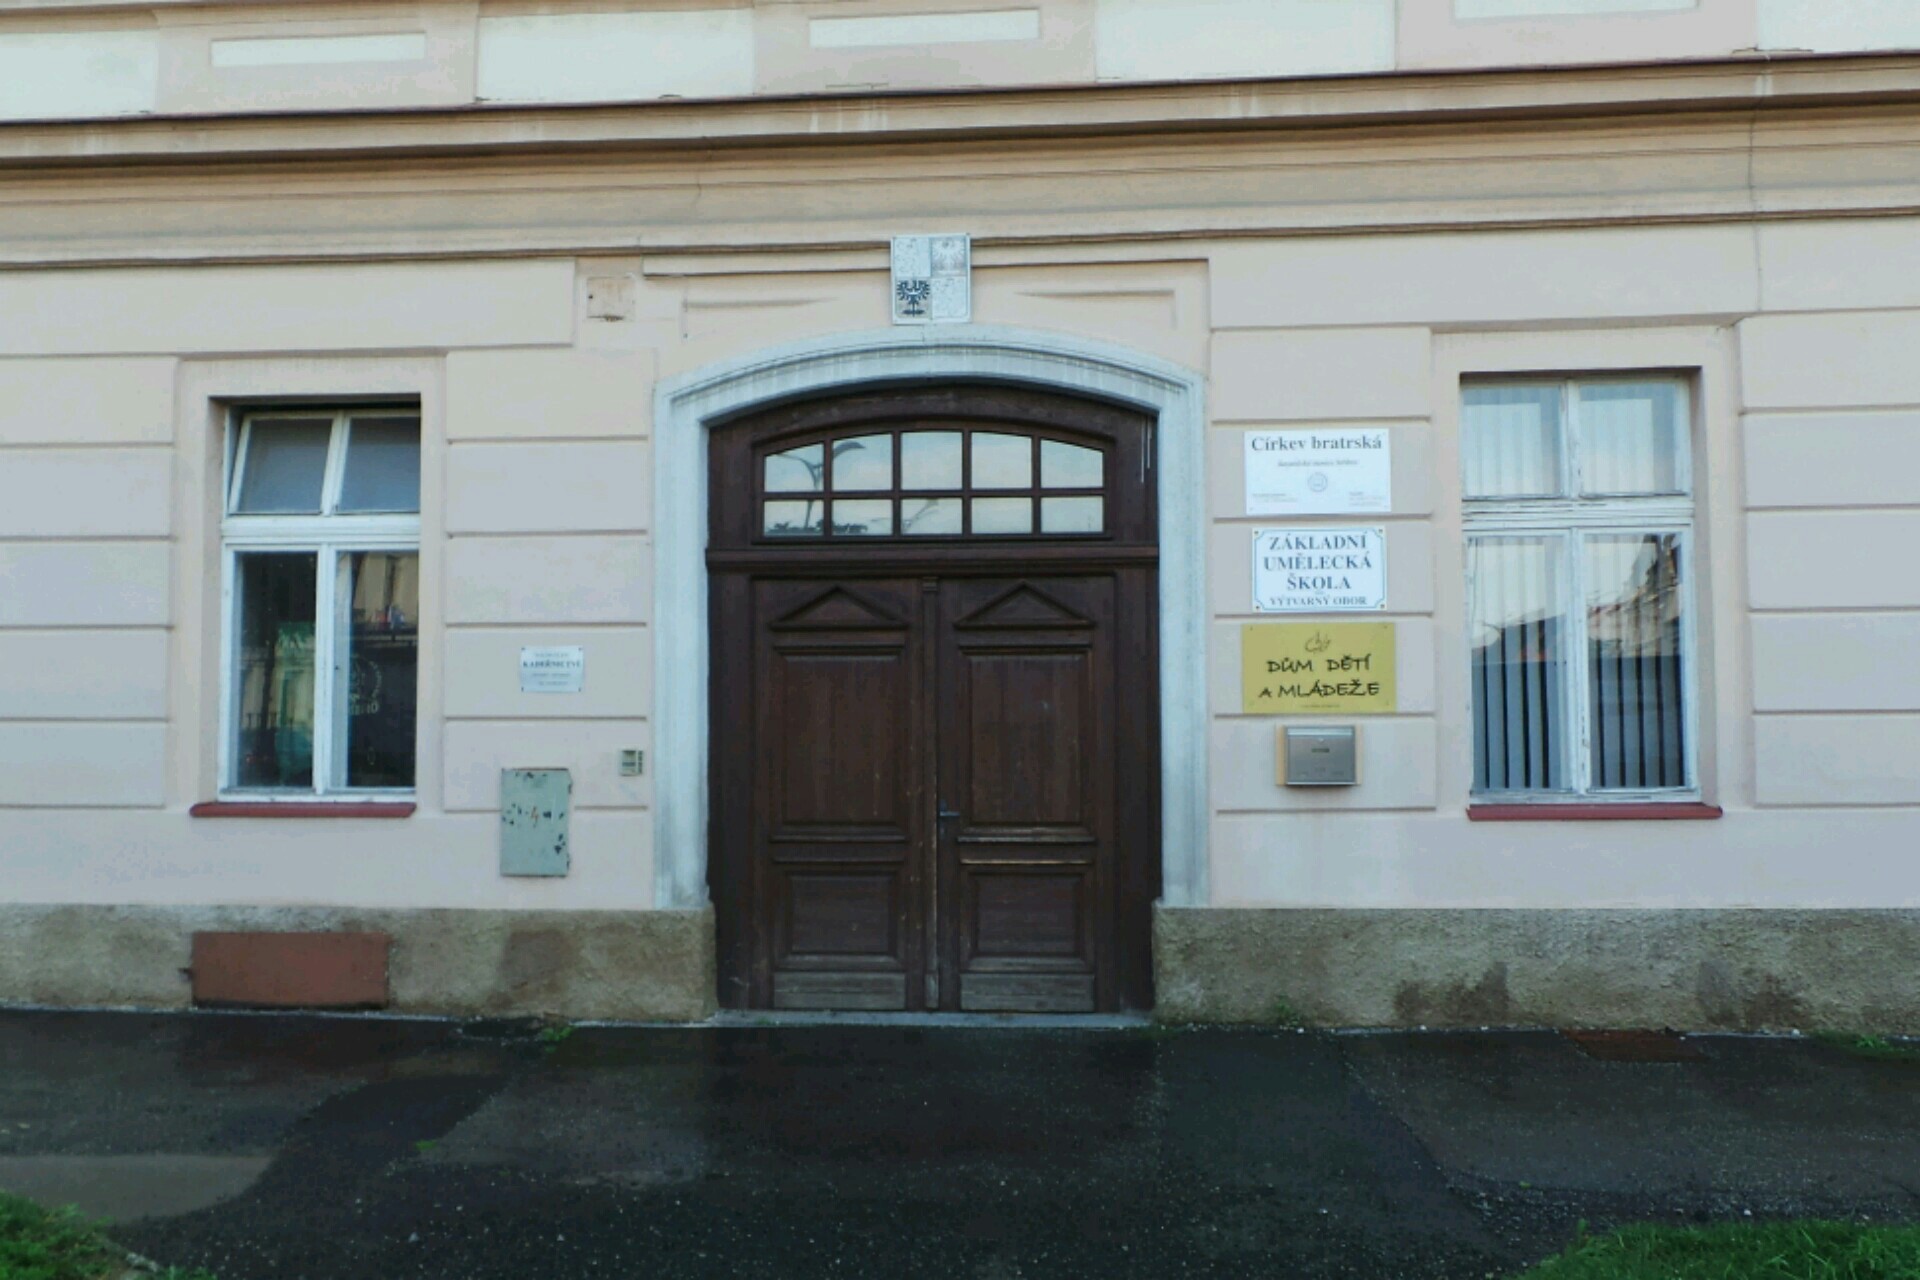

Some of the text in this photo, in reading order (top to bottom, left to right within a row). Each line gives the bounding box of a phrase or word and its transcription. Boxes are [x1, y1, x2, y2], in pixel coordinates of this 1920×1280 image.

[1251, 434, 1382, 451] Církev bratrská
[1269, 532, 1368, 550] ZÁKLADNÍ
[1263, 551, 1372, 571] UMĚLECKÁ
[1287, 574, 1352, 591] ŠKOLA
[1270, 595, 1367, 606] VÝTVARNÝ OBOR
[1266, 653, 1371, 673] DŮM DĚTÍ
[1258, 679, 1380, 698] A MLÁDEŽE
